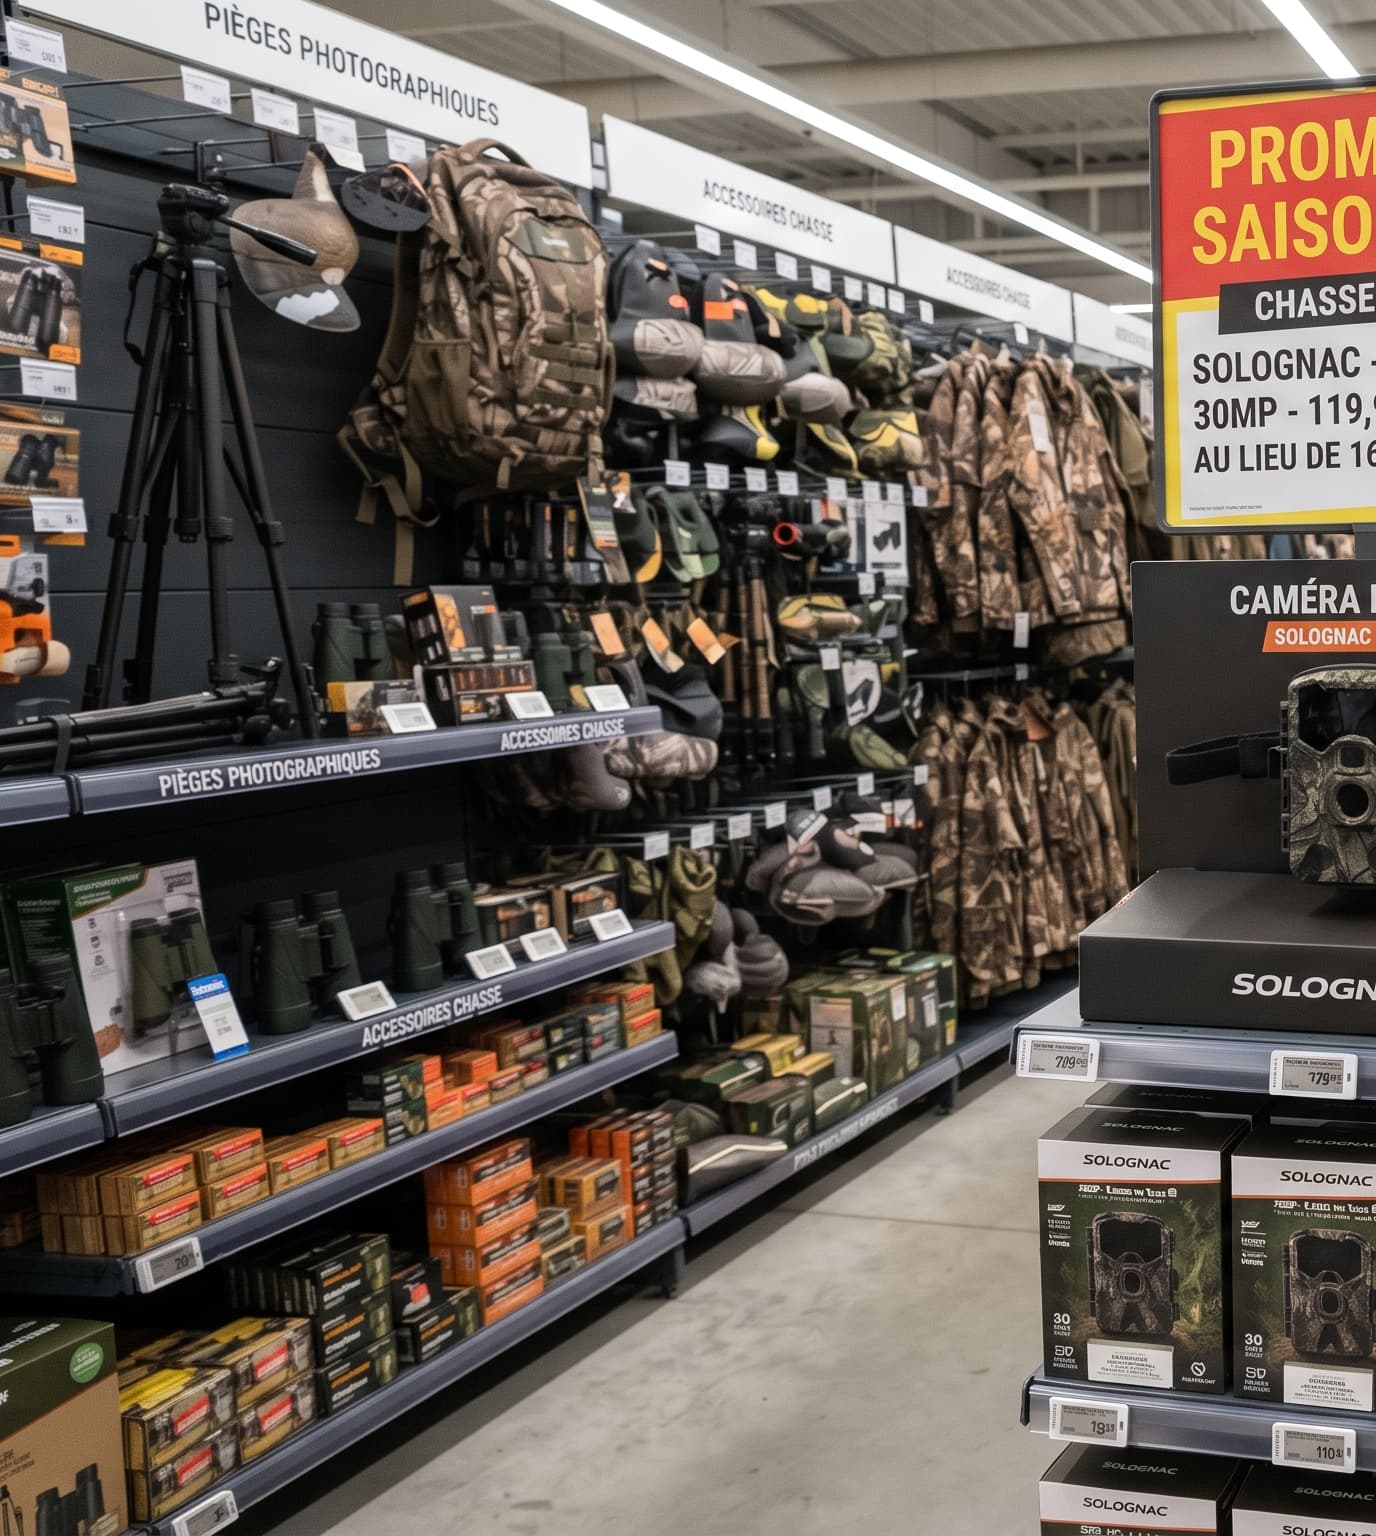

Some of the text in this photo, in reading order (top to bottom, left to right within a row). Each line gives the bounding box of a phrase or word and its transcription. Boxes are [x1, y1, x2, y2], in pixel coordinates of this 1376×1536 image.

[205, 3, 499, 126] PIÈGES PHOTOGRAPHIQUES
[703, 179, 833, 242] ACCESSOIRES CHASSE
[1255, 282, 1375, 321] CHASSE
[1192, 346, 1361, 384] SOLOGNAC
[1193, 396, 1278, 430] 30MP
[1193, 445, 1230, 474] AU
[1239, 443, 1297, 472] LIEU
[1307, 441, 1341, 469] DE
[1230, 577, 1362, 615] CAMÉRA
[1274, 626, 1372, 646] SOLOGNAC
[501, 718, 625, 751] ACCESSOIRES CHASSE
[159, 748, 381, 797] PIÈGES PHOTOGRAPHIQUES
[362, 985, 503, 1048] ACCESSOIRES CHASSE
[1101, 1122, 1184, 1132] SOLOGNAC
[1083, 1154, 1171, 1170] SOLOGNAC
[1280, 1170, 1373, 1187] SOLOGNAC
[1053, 1313, 1071, 1325] 30
[1244, 1333, 1263, 1346] 30
[1101, 1461, 1179, 1475] SOLOGNAC
[1083, 1497, 1169, 1517] SOLOGNAC
[1294, 1487, 1376, 1501] SOLOGNAC
[1282, 1525, 1372, 1536] SOLOG
